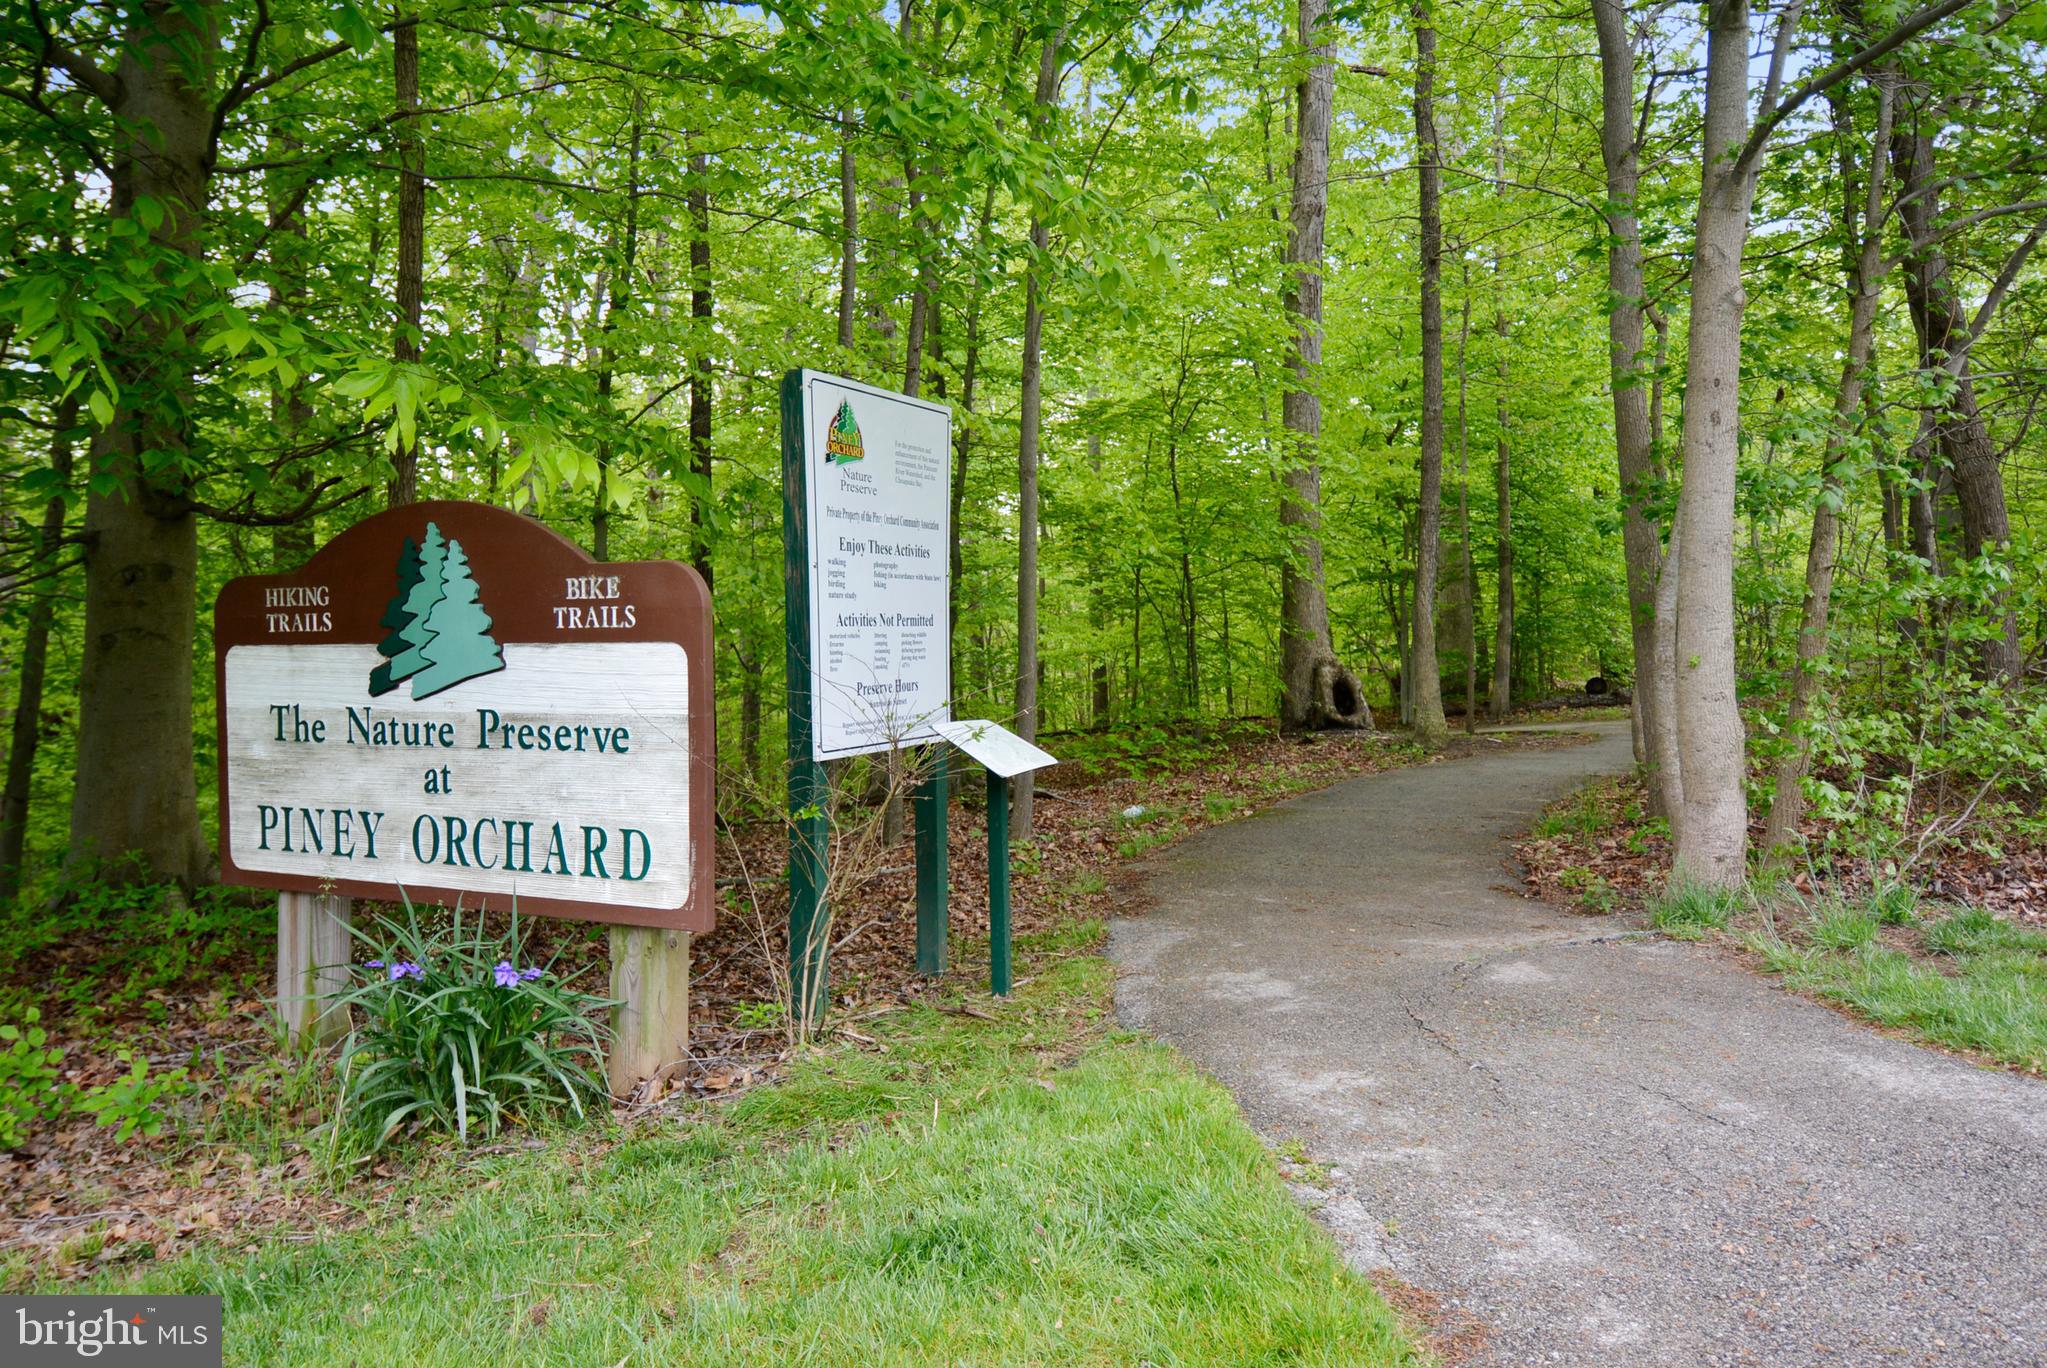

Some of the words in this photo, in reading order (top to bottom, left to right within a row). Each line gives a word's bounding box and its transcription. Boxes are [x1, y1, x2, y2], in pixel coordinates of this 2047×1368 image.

[830, 427, 861, 447] PINEY
[826, 441, 865, 459] ORCHARD
[842, 467, 873, 483] Nature
[840, 479, 878, 496] Preserve
[827, 505, 842, 518] Private
[842, 508, 860, 524] Property
[884, 514, 899, 526] Orchard
[839, 536, 866, 557] Enjoy
[868, 539, 893, 556] These
[894, 543, 931, 559] Activities
[827, 558, 847, 568] walking
[265, 586, 329, 608] HIKING
[565, 576, 621, 600] BIKE
[265, 612, 332, 633] TRAILS
[553, 605, 636, 629] TRAILS
[836, 612, 877, 628] Activities
[879, 613, 894, 627] Not
[896, 613, 934, 627] Permitted
[856, 681, 896, 697] Preserve
[895, 679, 919, 693] Hours
[269, 704, 326, 744] The
[345, 706, 455, 748] Nature
[476, 708, 630, 754] Preserve
[423, 764, 452, 794] at
[257, 804, 384, 860] PINEY
[411, 814, 652, 881] ORCHARD
